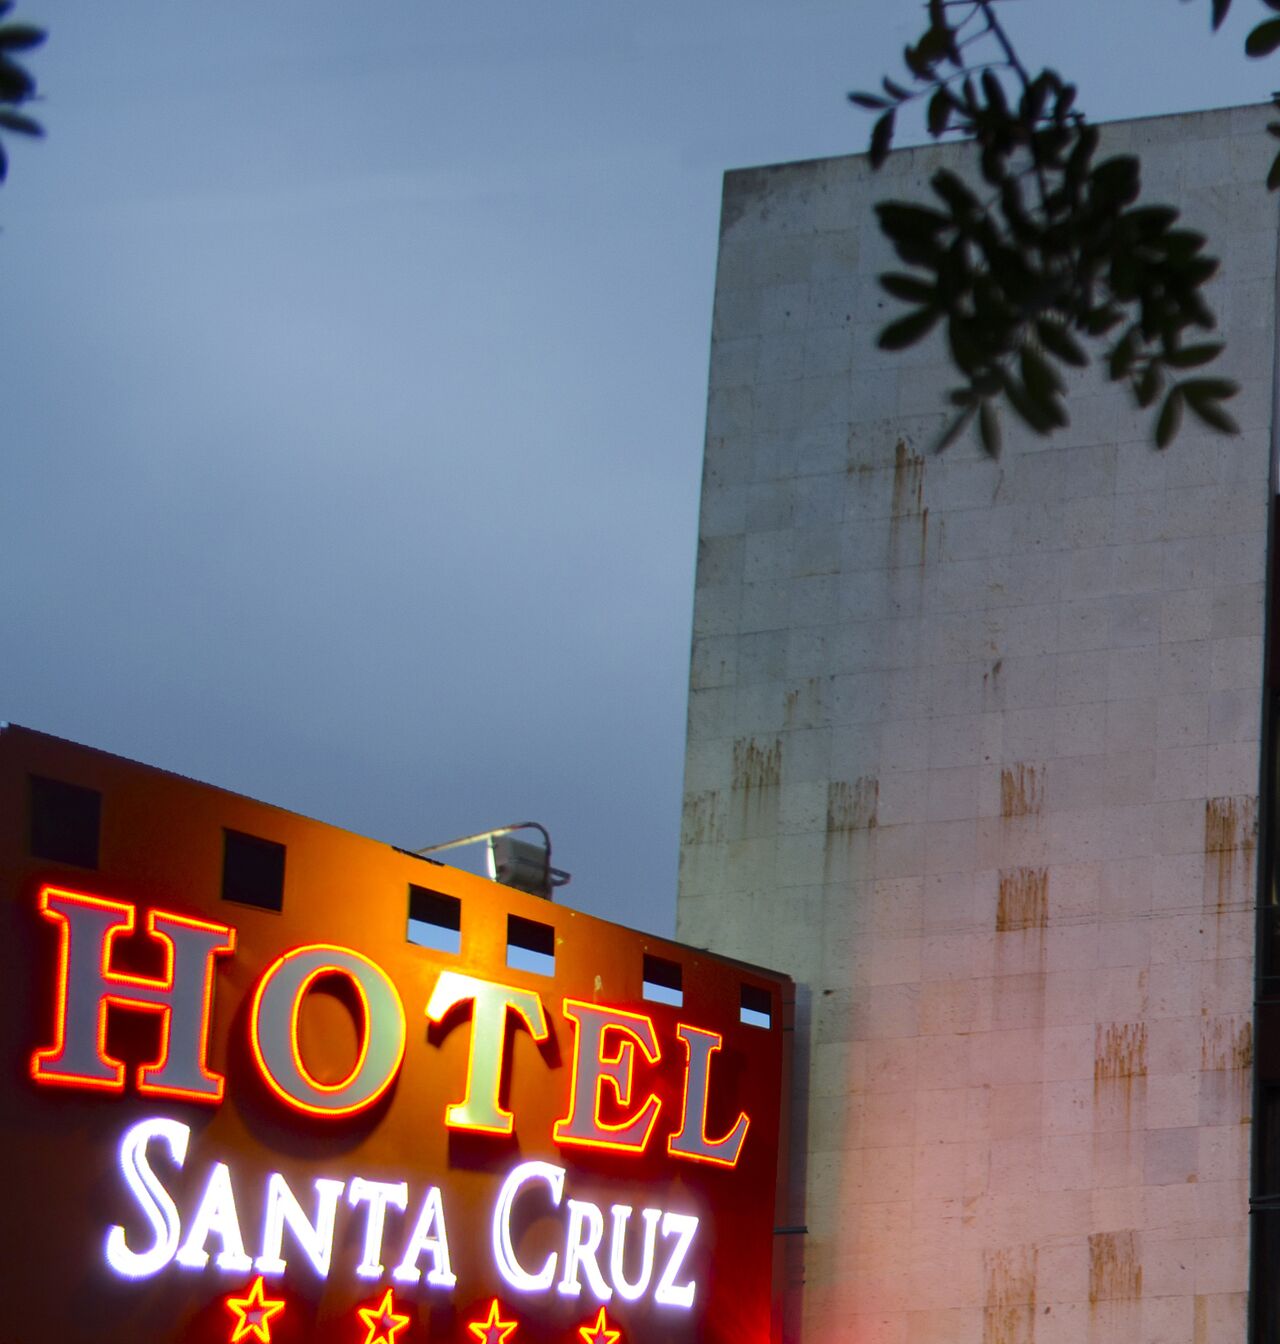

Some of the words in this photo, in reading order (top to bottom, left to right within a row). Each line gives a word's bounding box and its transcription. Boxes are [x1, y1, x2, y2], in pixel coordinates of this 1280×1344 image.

[31, 884, 750, 1168] HOTEL
[106, 1116, 457, 1288] SANTA
[492, 1160, 698, 1308] CRUZ
